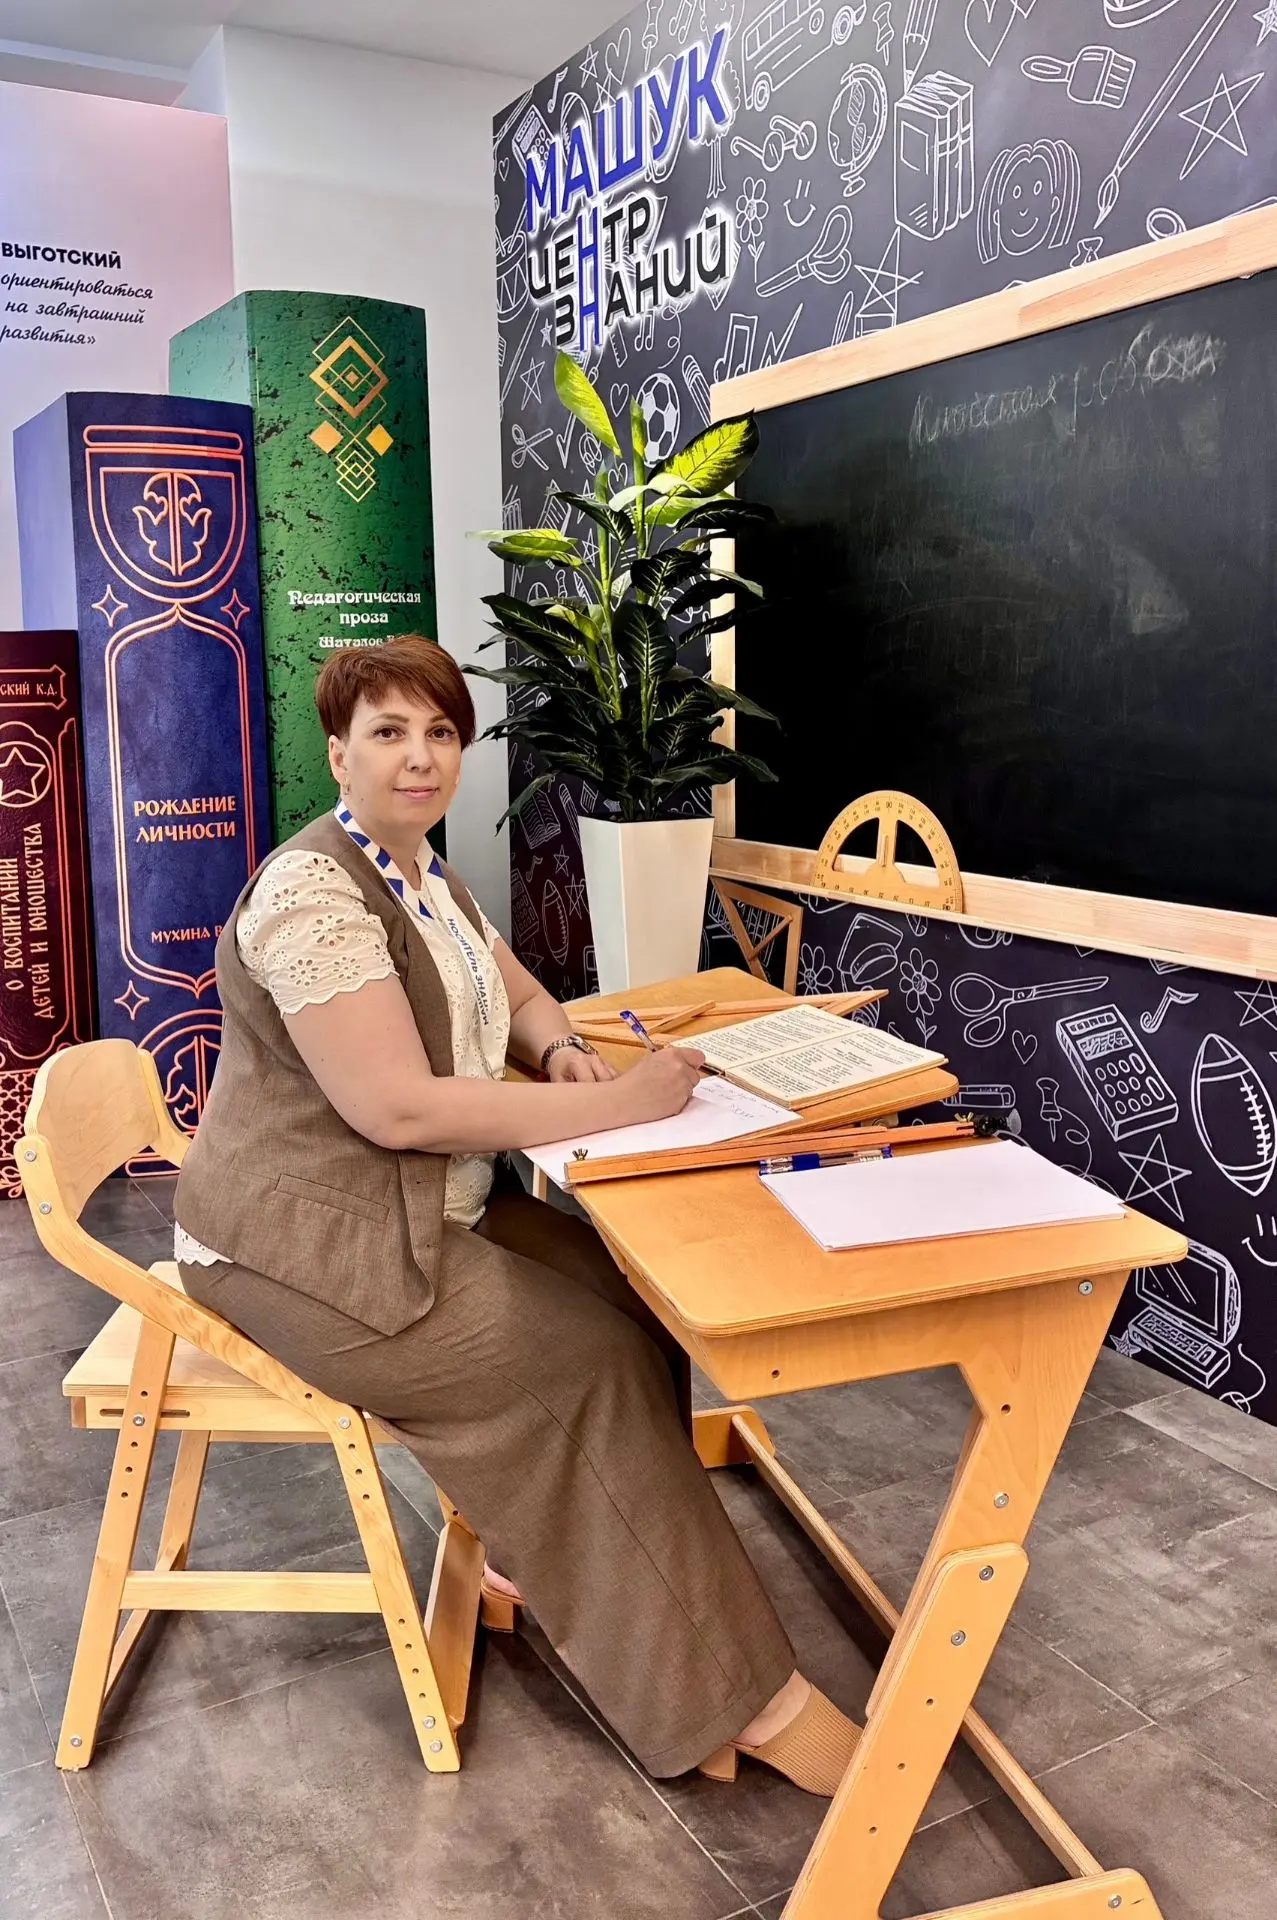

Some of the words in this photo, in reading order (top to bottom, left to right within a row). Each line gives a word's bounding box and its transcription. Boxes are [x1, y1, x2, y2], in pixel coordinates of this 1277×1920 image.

[525, 27, 727, 233] МАШУК
[1, 242, 121, 269] ВЫГОТСКИЙ
[527, 197, 650, 300] ЦЕНТР
[1, 273, 153, 299] ориентироваться
[555, 213, 727, 351] ЗНАНИЙ
[5, 301, 28, 313] на
[36, 302, 145, 323] завтрашний
[0, 325, 96, 344] развития»
[287, 590, 421, 606] Педагогическая
[339, 612, 389, 627] проза
[36, 683, 58, 696] К.Д.
[133, 796, 236, 816] РОЖДЕНИЕ
[136, 821, 236, 843] ЛИЧНОСТИ
[24, 823, 48, 932] ЮНОШЕСТВА
[0, 858, 24, 969] ВОСПИТАНИИ
[151, 926, 211, 944] МУХИНА
[447, 918, 478, 973] НОСИТЕЛЬ
[30, 941, 49, 953] И
[5, 979, 24, 991] О
[28, 963, 55, 1019] ДЕТЕЙ
